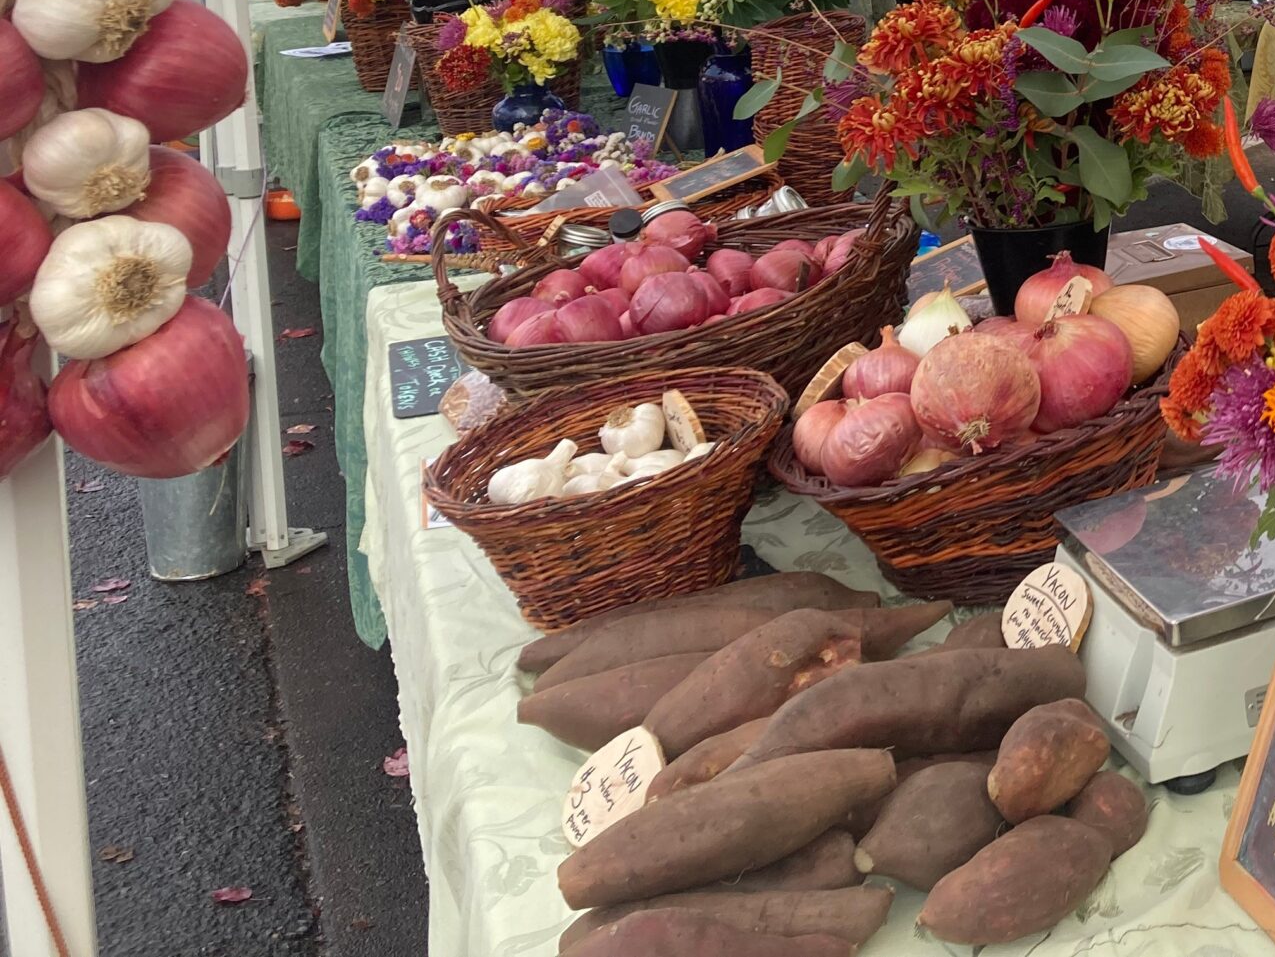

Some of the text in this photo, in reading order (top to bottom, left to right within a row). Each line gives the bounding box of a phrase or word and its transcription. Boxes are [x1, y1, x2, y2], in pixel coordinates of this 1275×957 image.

[628, 95, 660, 118] GARLIC
[424, 340, 450, 363] CASH
[1041, 565, 1077, 611] YACON
[614, 738, 643, 794] YACON
[577, 809, 591, 825] per
